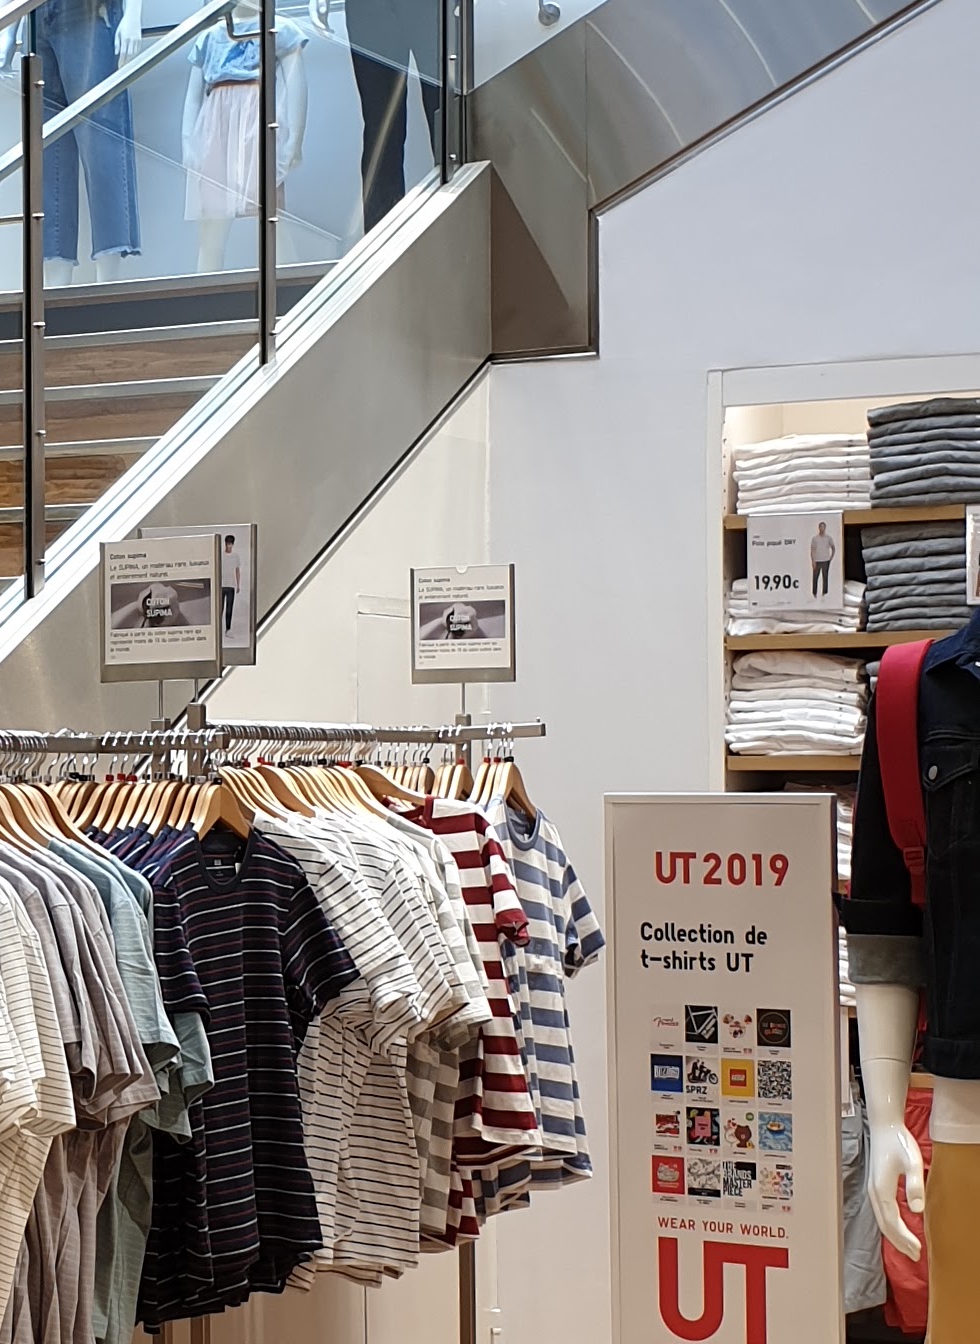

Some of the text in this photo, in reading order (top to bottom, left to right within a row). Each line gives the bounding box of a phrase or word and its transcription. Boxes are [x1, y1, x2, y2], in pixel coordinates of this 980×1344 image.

[655, 851, 790, 886] UT 2019
[640, 921, 768, 945] Collection de
[640, 949, 754, 973] t-shirts UT
[685, 1085, 708, 1095] SPRZ
[722, 1177, 753, 1189] MASTER
[658, 1216, 789, 1239] WEAR YOUR WORLD.
